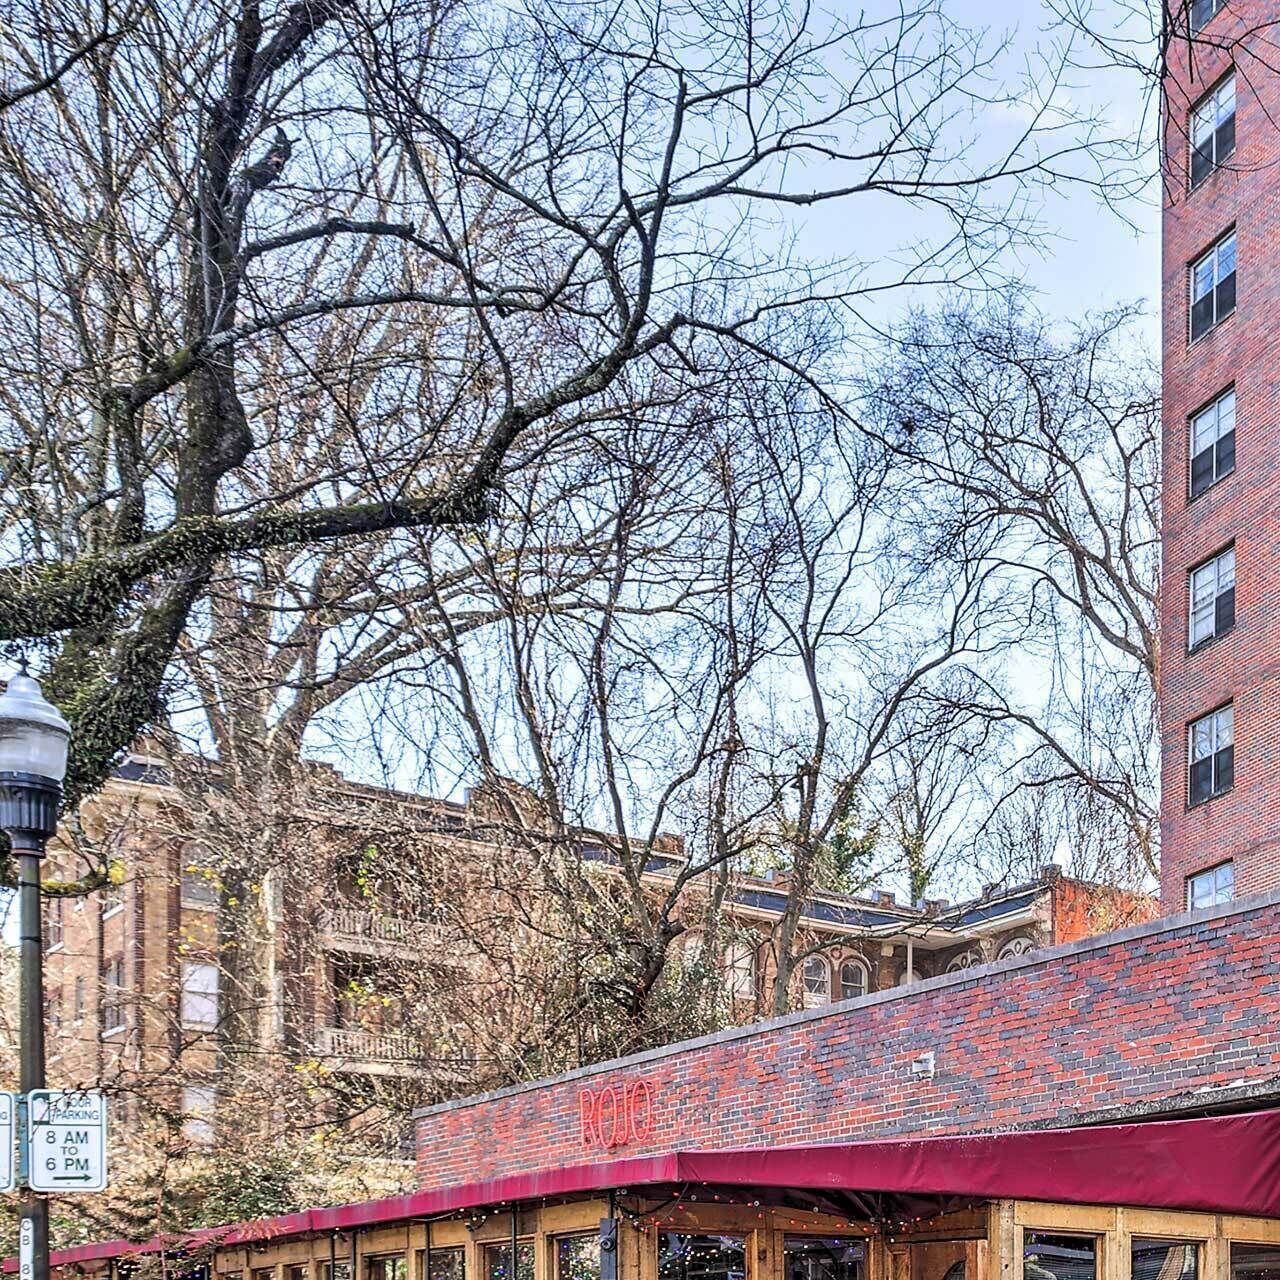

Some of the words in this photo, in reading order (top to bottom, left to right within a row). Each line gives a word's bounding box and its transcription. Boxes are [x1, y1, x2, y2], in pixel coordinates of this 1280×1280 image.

[55, 1110, 100, 1120] PARKING
[580, 1080, 652, 1149] ROJO
[46, 1130, 56, 1144] 8
[63, 1131, 89, 1144] AM
[60, 1146, 79, 1156] TO
[45, 1157, 56, 1171] 6
[64, 1158, 89, 1171] PM
